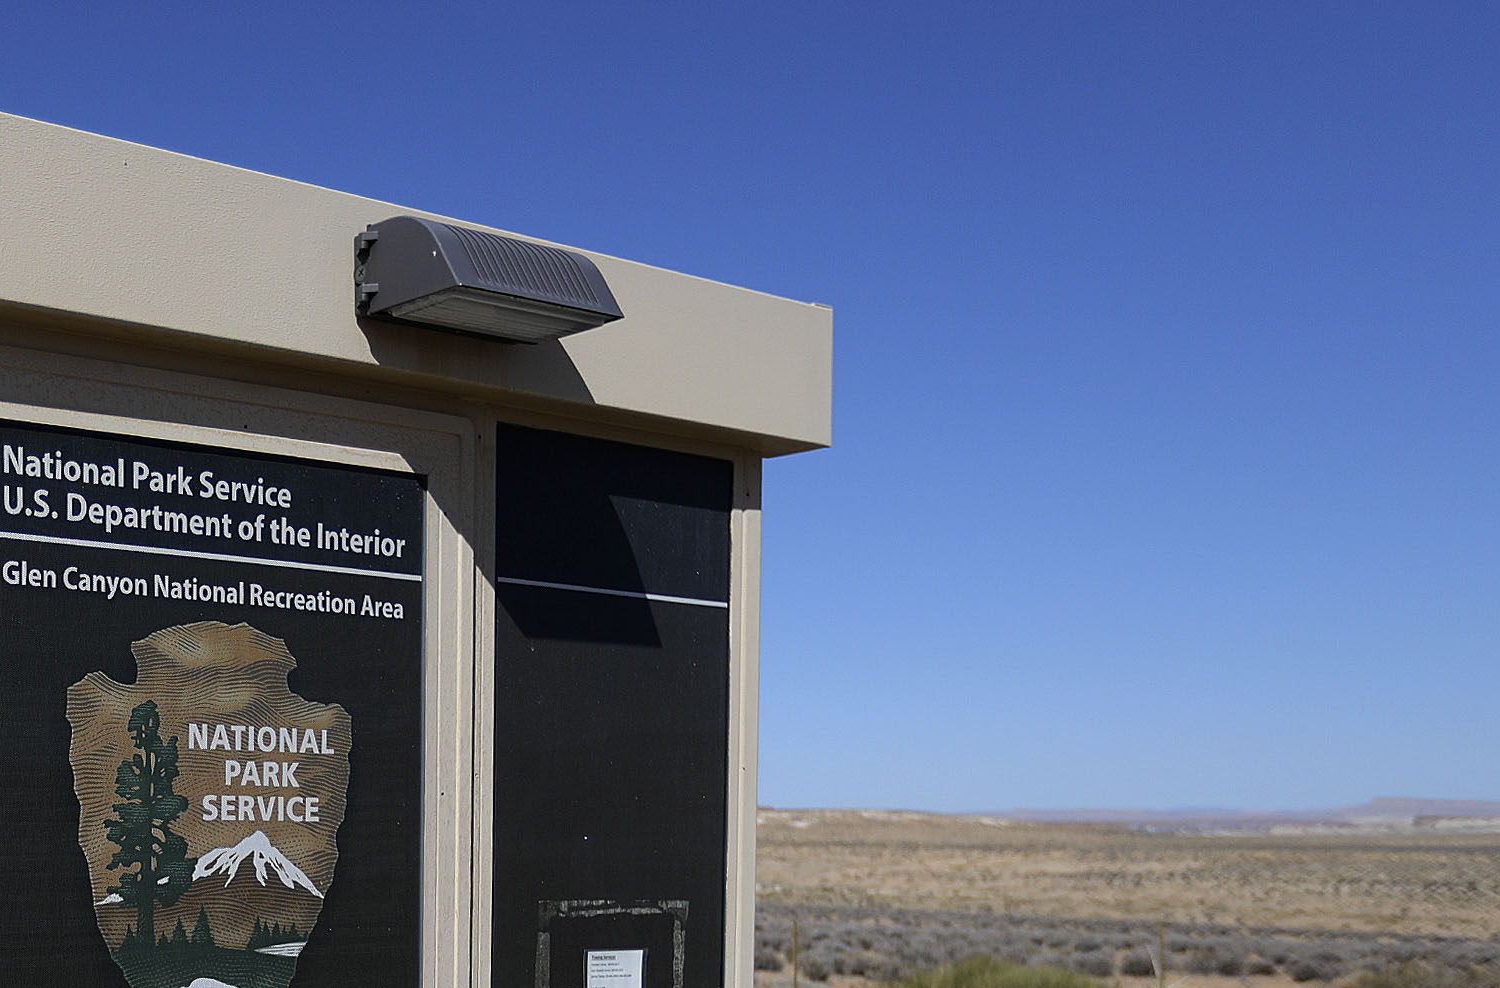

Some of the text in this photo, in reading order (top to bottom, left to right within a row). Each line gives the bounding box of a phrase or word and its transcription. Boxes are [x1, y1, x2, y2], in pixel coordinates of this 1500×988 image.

[3, 445, 292, 508] National Park Service
[3, 485, 406, 558] U.S. Department of the Interior
[2, 560, 404, 620] Glen Canyon National Recreation Area
[187, 723, 335, 755] NATIONAL
[225, 760, 300, 788] PARK
[202, 794, 320, 822] SERVICE
